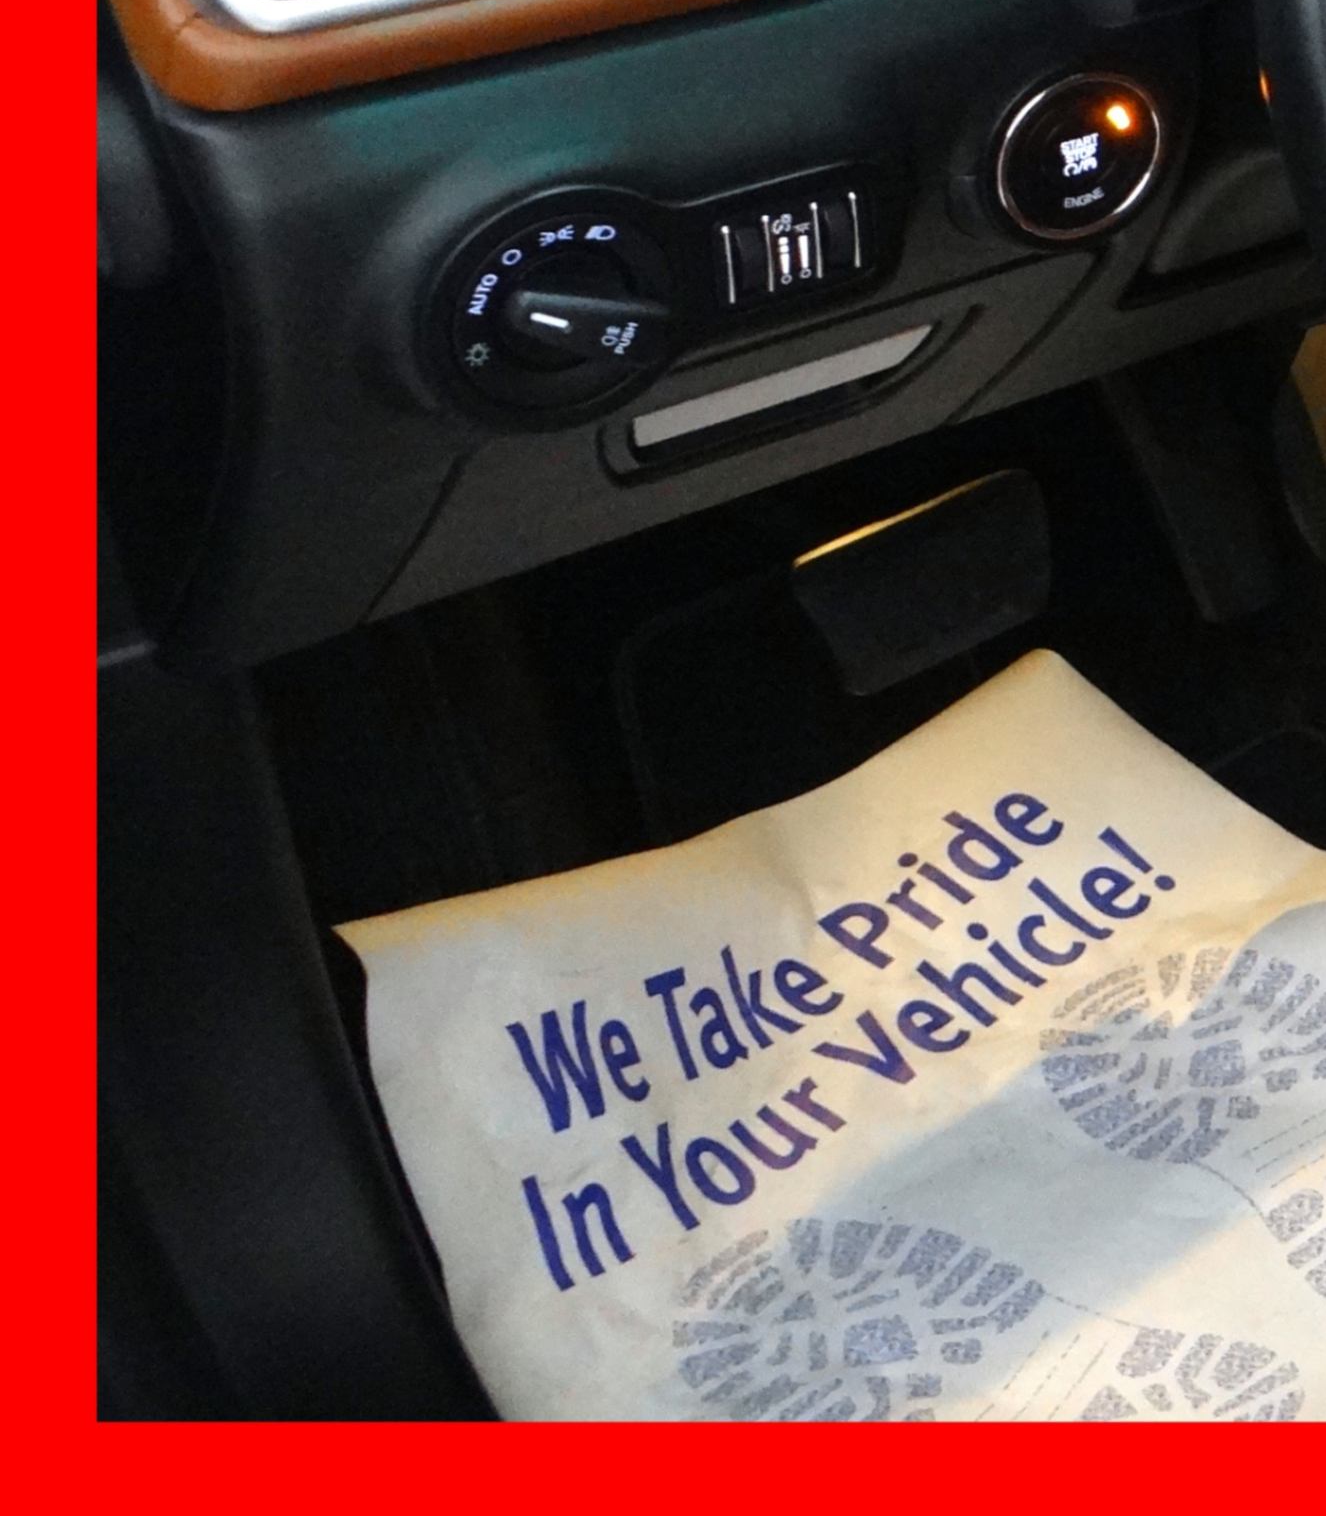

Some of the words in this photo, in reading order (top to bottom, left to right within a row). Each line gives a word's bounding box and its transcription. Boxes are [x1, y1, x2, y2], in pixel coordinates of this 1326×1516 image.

[1060, 132, 1100, 154] START
[1062, 145, 1098, 165] STOP
[1063, 187, 1104, 208] ENGINE
[466, 273, 499, 316] AUTO
[613, 321, 639, 355] PUSH
[506, 998, 648, 1135] We
[644, 944, 843, 1081] Take
[818, 791, 1064, 970] Pride
[521, 1174, 634, 1292] In
[620, 1065, 848, 1232] Your
[814, 827, 1175, 1085] Vehicle!
